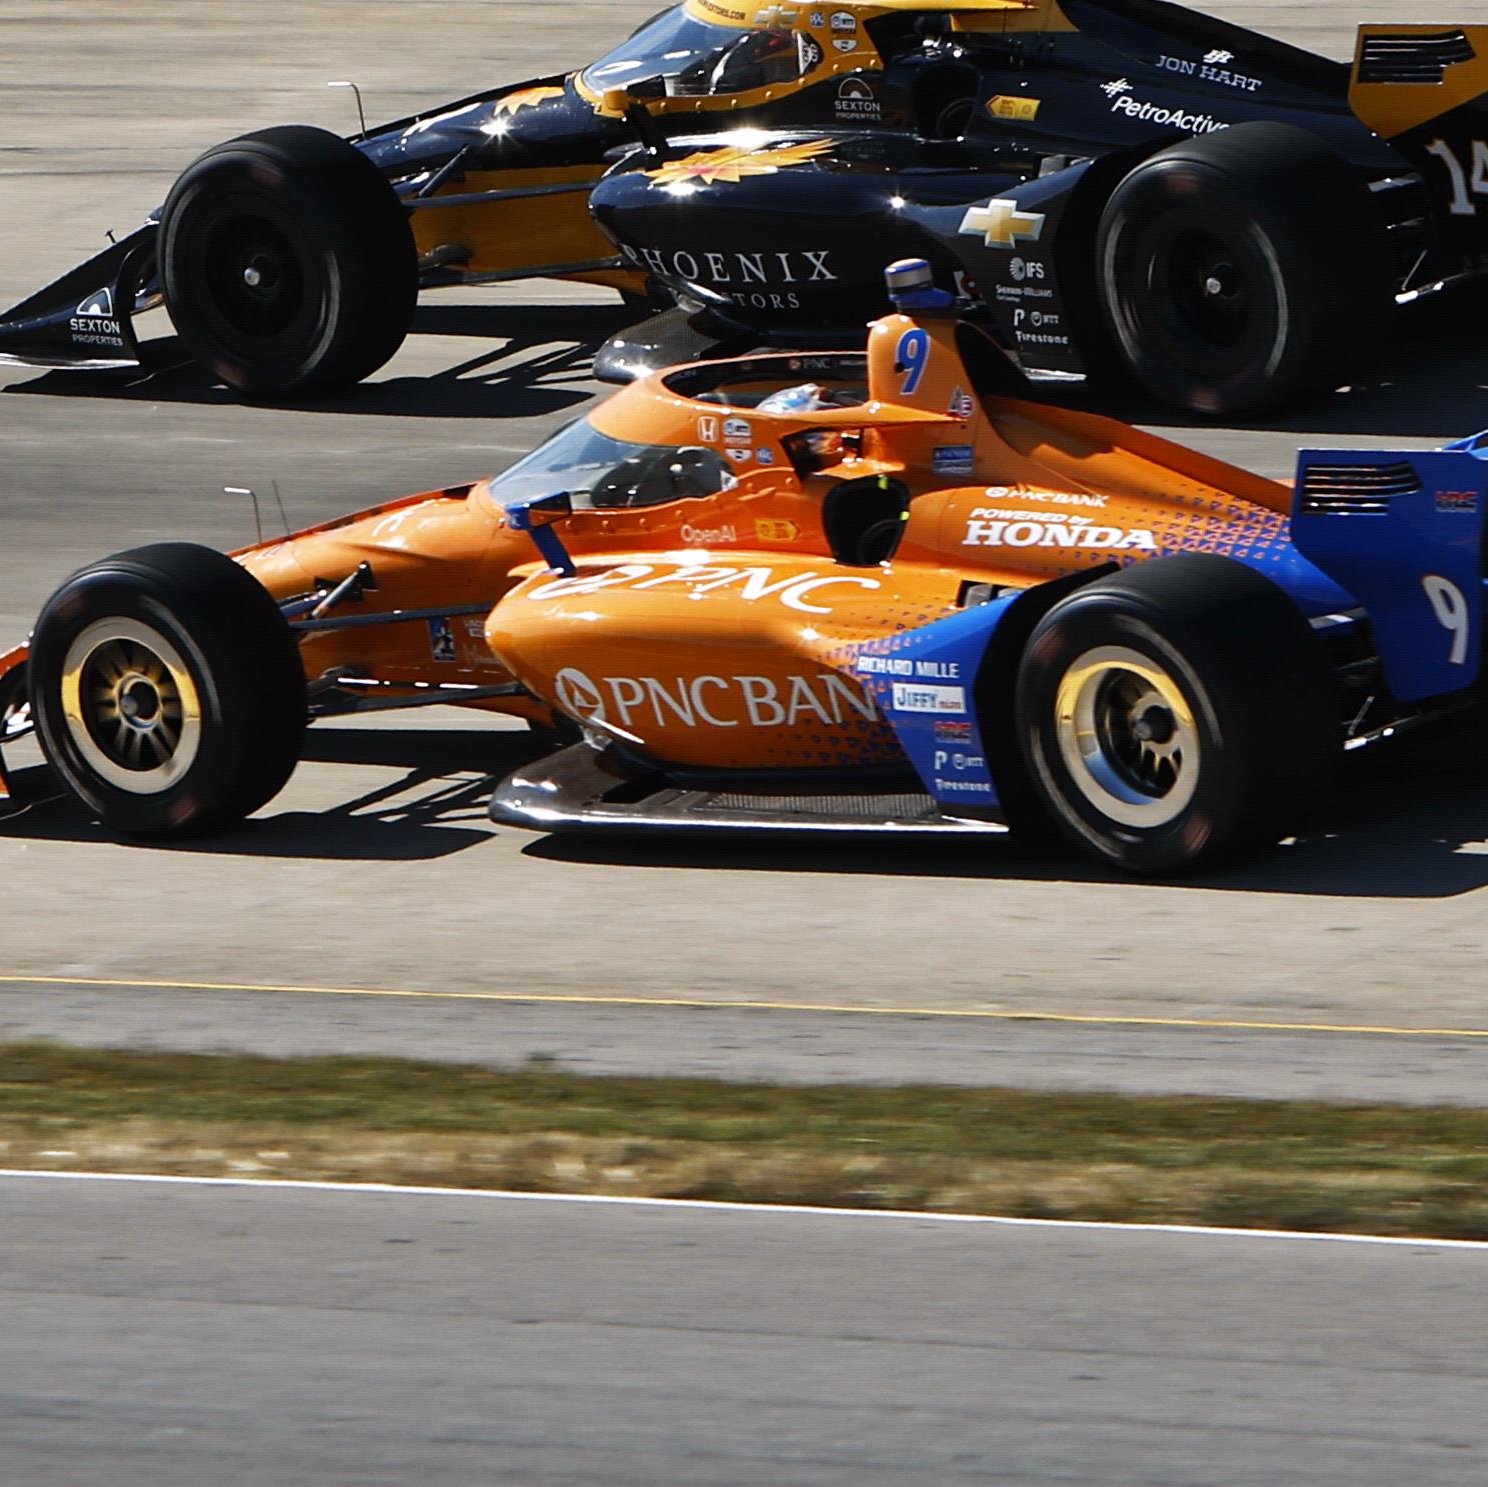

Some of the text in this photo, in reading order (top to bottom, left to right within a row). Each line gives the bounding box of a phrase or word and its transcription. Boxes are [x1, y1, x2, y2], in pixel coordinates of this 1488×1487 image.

[1154, 55, 1262, 92] JON HART
[834, 100, 880, 112] SEXTON
[835, 113, 881, 121] PROPERTIES
[620, 243, 838, 283] PHOENIX
[1026, 262, 1045, 279] IFS
[70, 318, 120, 334] SEXTON
[72, 334, 123, 347] PROPERTIES
[1015, 331, 1069, 344] Firestone
[896, 328, 931, 396] 9
[969, 507, 1095, 526] POWERED by
[961, 520, 1158, 550] HONDA
[630, 565, 881, 614] PNC
[1422, 575, 1469, 665] 9
[856, 656, 961, 679] RICHARD MILLE
